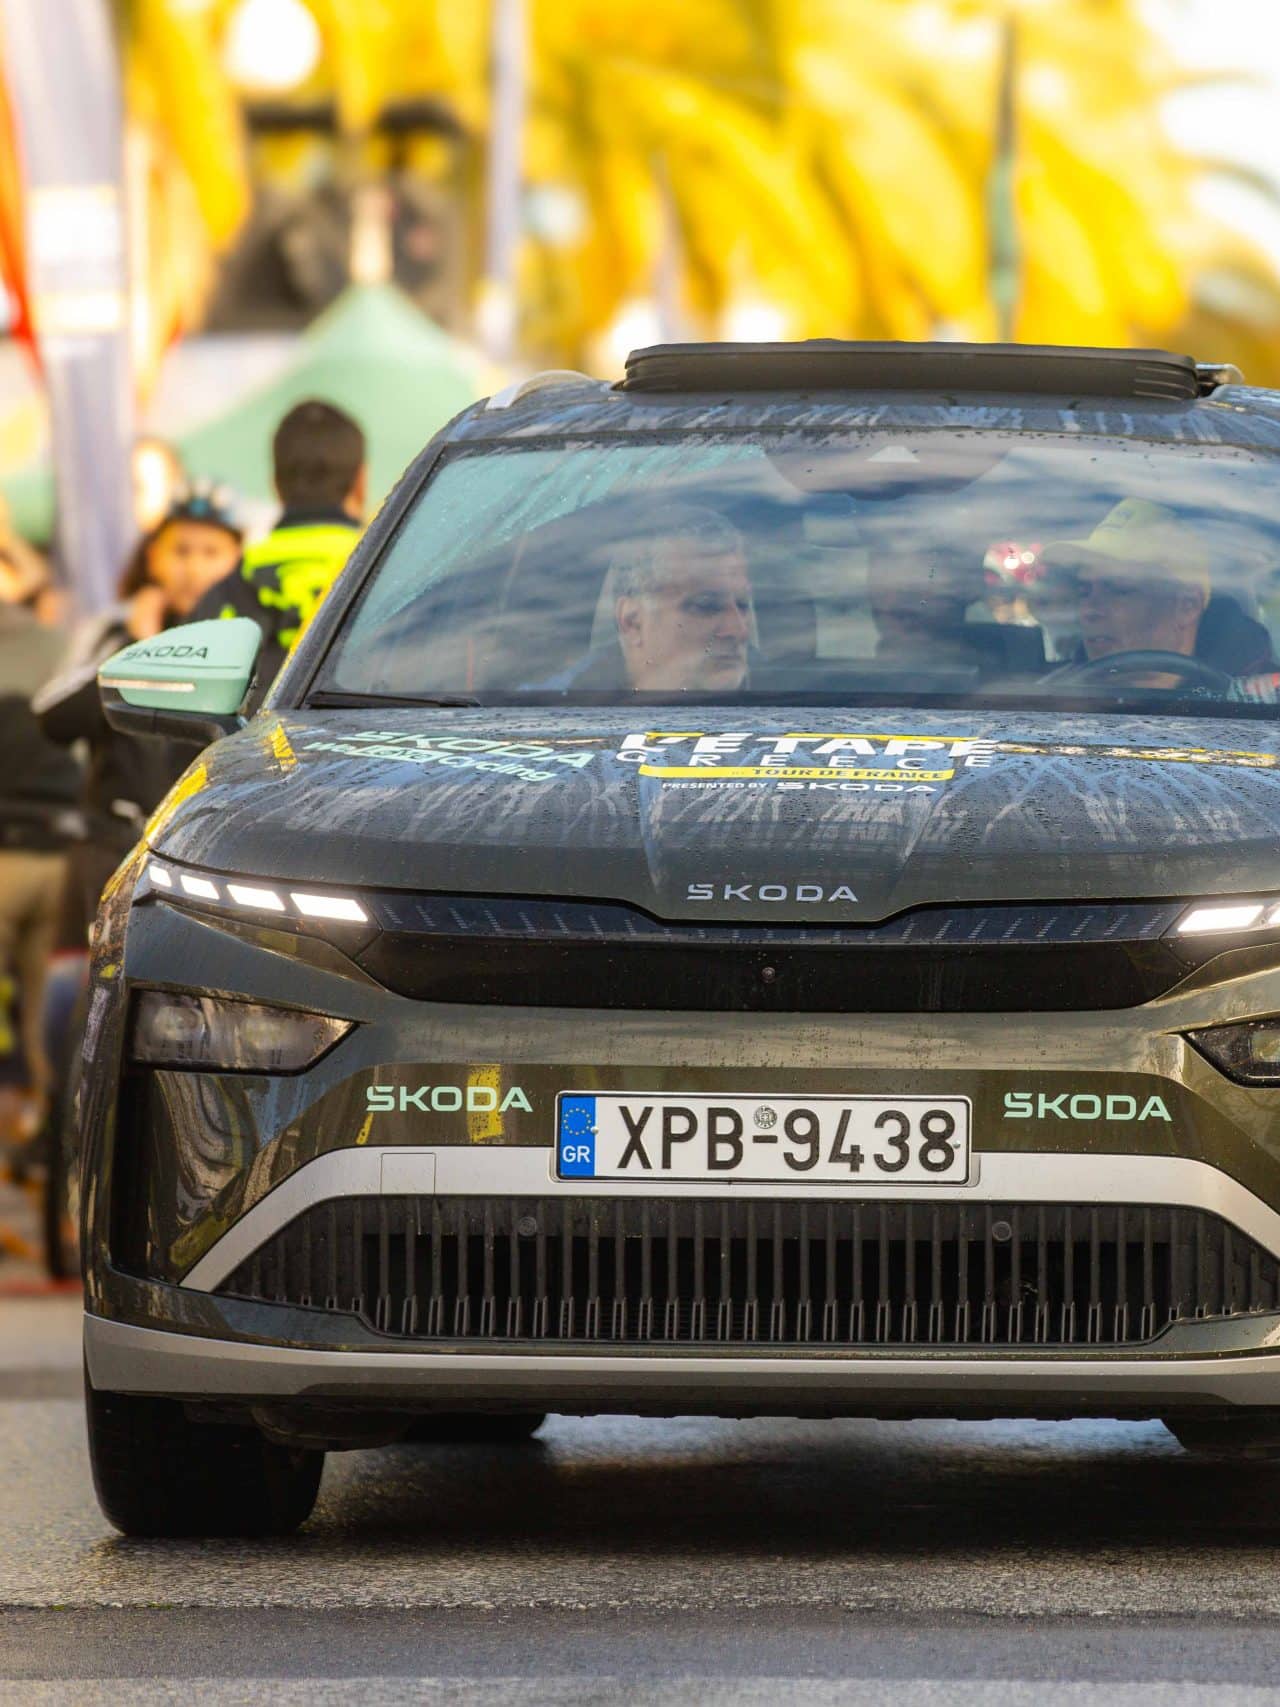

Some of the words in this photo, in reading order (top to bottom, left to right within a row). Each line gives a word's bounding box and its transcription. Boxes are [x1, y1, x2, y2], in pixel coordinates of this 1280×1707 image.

[616, 751, 993, 769] GREECE
[752, 768, 813, 776] TOUR
[852, 770, 945, 779] FRANCE
[562, 1145, 591, 1163] GR
